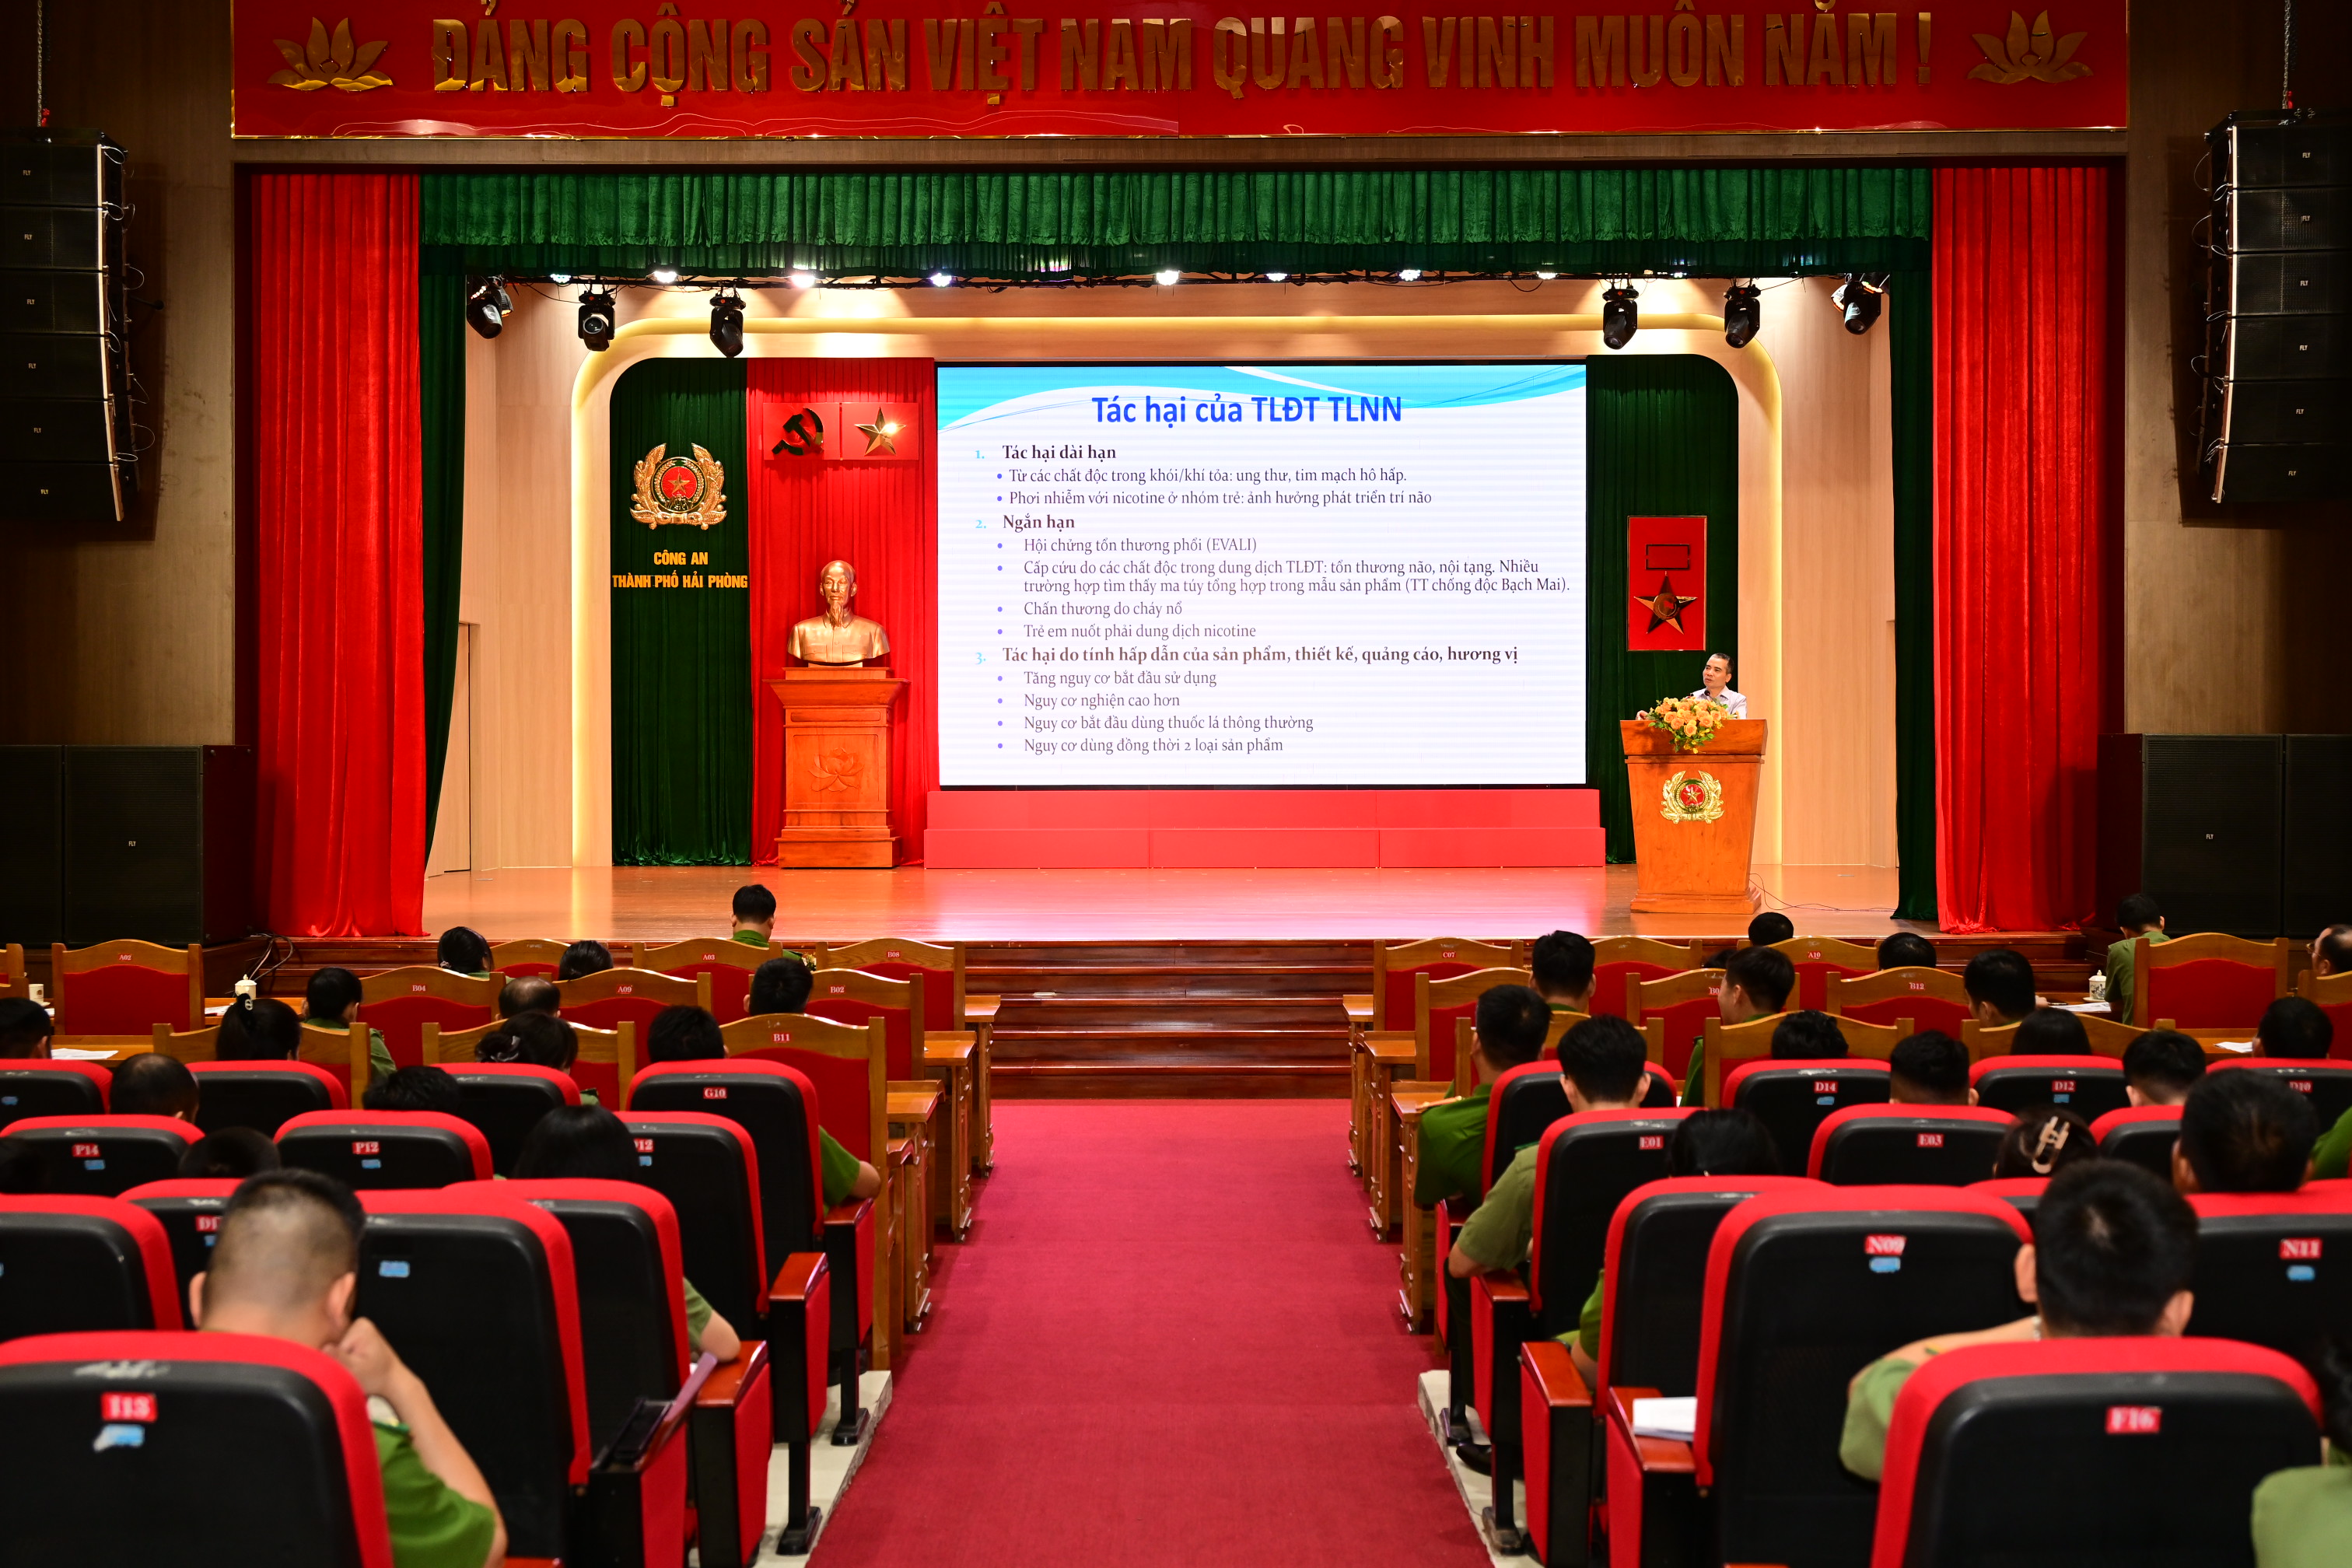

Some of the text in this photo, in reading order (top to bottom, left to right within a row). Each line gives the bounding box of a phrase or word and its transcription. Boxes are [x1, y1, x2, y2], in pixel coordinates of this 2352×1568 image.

[431, 0, 590, 93] ĐẢNG
[611, 2, 770, 107] CỘNG
[791, 0, 906, 92] SẢN
[923, 2, 1043, 105] VIỆT
[1061, 19, 1192, 91] NAM
[1213, 16, 1405, 99] QUANG
[1422, 16, 1554, 89] VINH
[1576, 0, 1745, 88] MUÔN
[1766, 0, 1897, 85] NĂM
[1092, 393, 1402, 428] Tác hại của TLĐT TLNN
[1003, 445, 1027, 459] Tác
[1031, 445, 1055, 462] hại
[1060, 445, 1083, 458] dài
[1087, 445, 1116, 462] hạn
[1009, 467, 1406, 485] Từ các chất độc trong khói/khí tỏa: ung thư, tim mạch hô hấp.
[1010, 489, 1431, 507] Phơi nhiễm với nicotine ở nhóm trẻ: ảnh hưởng phát triển trí não
[1003, 513, 1041, 533] Ngắn
[1047, 514, 1074, 532] hạn
[1024, 539, 1047, 554] Hội
[1096, 537, 1117, 551] tổn
[1121, 538, 1170, 555] thương
[1174, 537, 1201, 554] phổi
[1207, 537, 1256, 553] (EVALI)
[653, 549, 709, 565] CÔNG AN
[612, 570, 748, 588] THÀNH PHỐ HẢI PHÒNG
[1024, 601, 1181, 618] Chấn thương do cháy nổ
[1024, 624, 1255, 641] Trẻ em nuốt phải dung dịch nicotine
[1003, 647, 1027, 661] Tác
[1032, 647, 1055, 665] hại
[1060, 647, 1079, 661] do
[1083, 647, 1114, 660] tính
[1119, 646, 1146, 664] hấp
[1151, 645, 1179, 660] dẫn
[1183, 647, 1209, 660] của
[1213, 647, 1238, 660] sản
[1243, 646, 1290, 664] phẩm,
[1295, 646, 1331, 660] thiết
[1336, 646, 1357, 663] kế,
[1362, 646, 1409, 664] quảng
[1413, 646, 1442, 663] cáo,
[1447, 646, 1501, 664] hương
[1505, 646, 1517, 663] vị
[1024, 670, 1216, 688] Tăng nguy cơ bắt đầu sử dụng
[1025, 715, 1313, 733] Nguy cơ bắt đầu dùng thuốc lá thông thường
[1025, 739, 1058, 755] Nguy
[1062, 742, 1076, 751] cơ
[1080, 738, 1113, 754] dùng
[1117, 737, 1149, 754] đồng
[1153, 738, 1180, 751] thời
[1195, 738, 1217, 753] loại
[1222, 739, 1242, 751] sản
[1247, 737, 1283, 754] phẩm
[704, 1089, 726, 1097] G10
[1815, 1081, 1836, 1092] D14
[2055, 1081, 2074, 1091] D12
[356, 1142, 378, 1153] P12
[1640, 1137, 1661, 1148] E01
[1920, 1135, 1941, 1145] E03
[75, 1146, 98, 1155] P14
[1868, 1237, 1906, 1253] N09
[2284, 1240, 2319, 1256] N11
